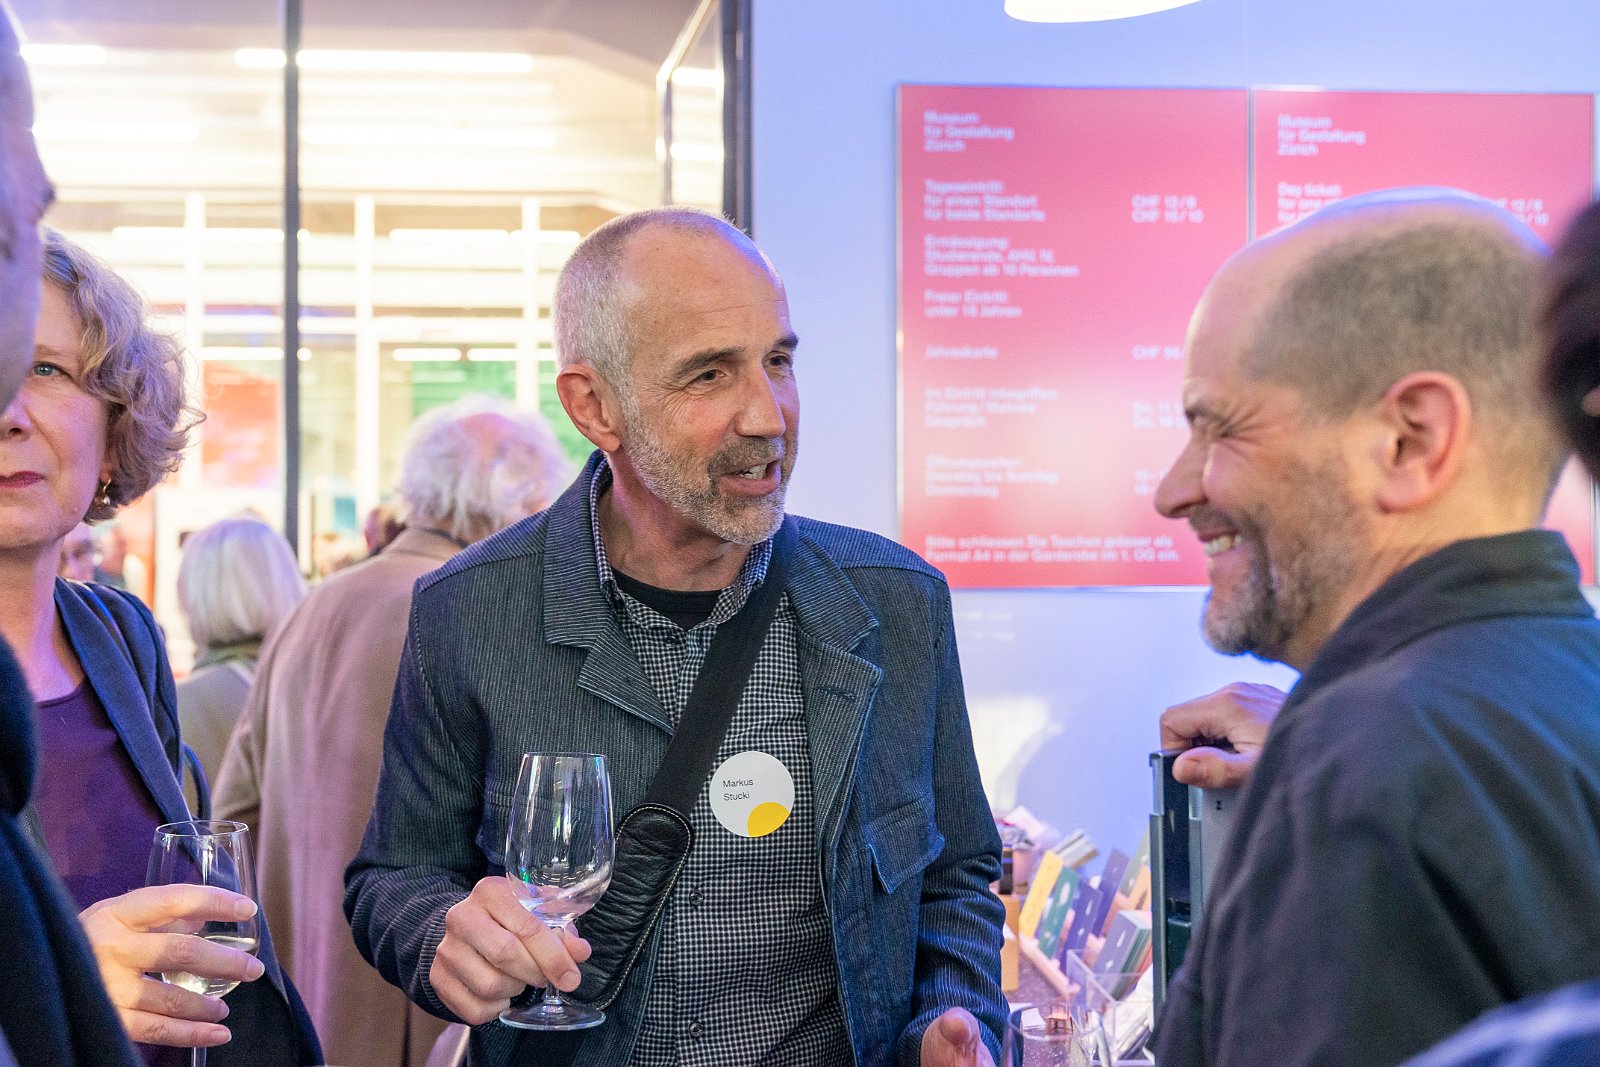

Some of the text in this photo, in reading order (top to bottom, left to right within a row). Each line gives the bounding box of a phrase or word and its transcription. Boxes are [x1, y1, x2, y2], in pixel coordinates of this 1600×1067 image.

[924, 110, 979, 123] Museum
[1278, 114, 1332, 128] Museum
[945, 125, 1014, 141] Gestaltung
[1298, 129, 1365, 145] Gestaltung
[925, 138, 965, 152] Zürich
[945, 195, 980, 207] einen
[984, 194, 1038, 207] Standort
[1131, 194, 1160, 209] CHF
[945, 207, 980, 220] beide
[984, 208, 1046, 221] Standorte
[1131, 208, 1160, 223] CHF
[925, 263, 980, 277] Gruppen
[1019, 263, 1080, 277] Personen
[980, 305, 1023, 318] Jahren
[1132, 345, 1160, 360] CHF
[722, 779, 754, 788] Markus
[723, 791, 750, 802] Stucki
